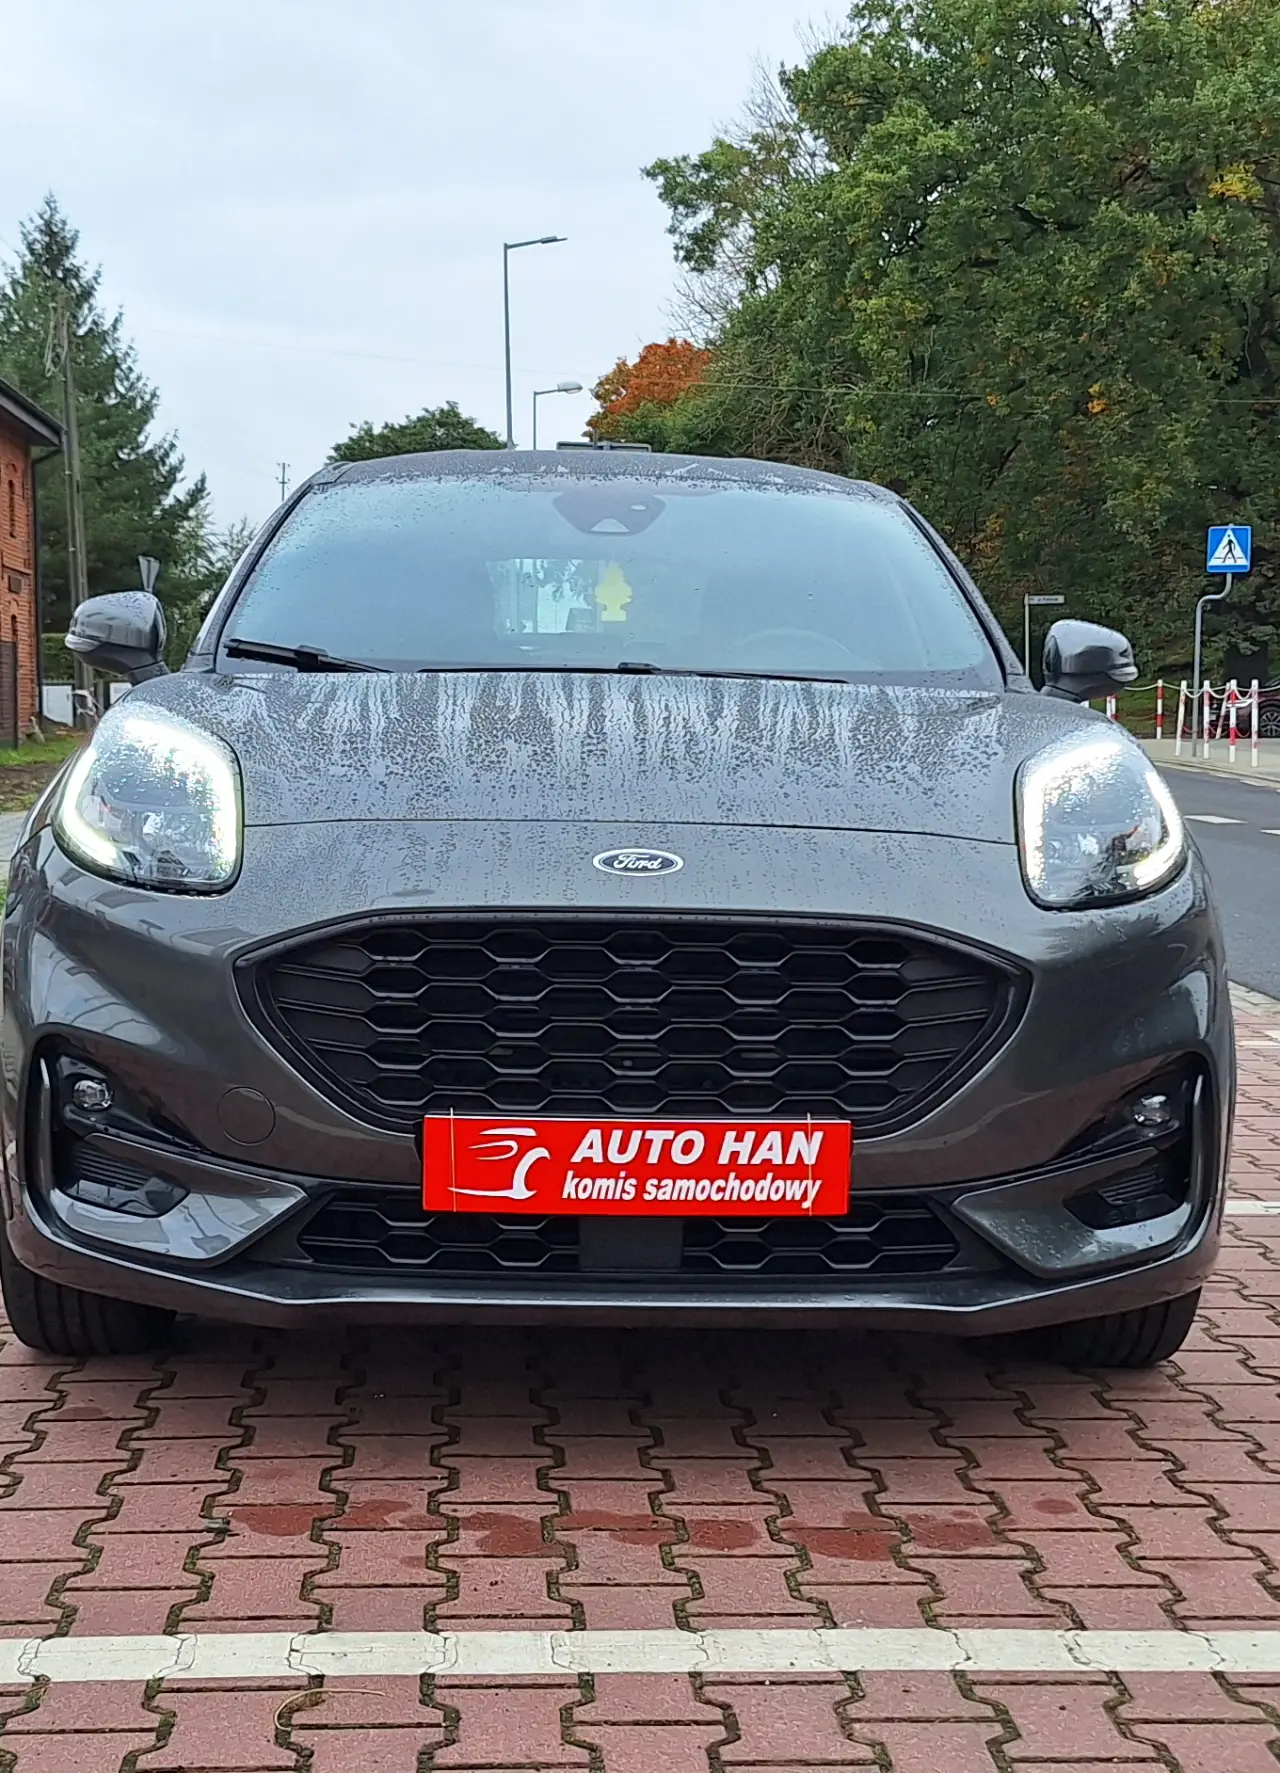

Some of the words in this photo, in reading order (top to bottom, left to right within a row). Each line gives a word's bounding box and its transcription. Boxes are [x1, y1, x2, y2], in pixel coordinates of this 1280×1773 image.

[613, 853, 663, 869] Ford
[569, 1128, 706, 1165] AUTO
[716, 1130, 825, 1165] HAN
[561, 1170, 637, 1200] komis
[642, 1172, 823, 1209] samochodowy
